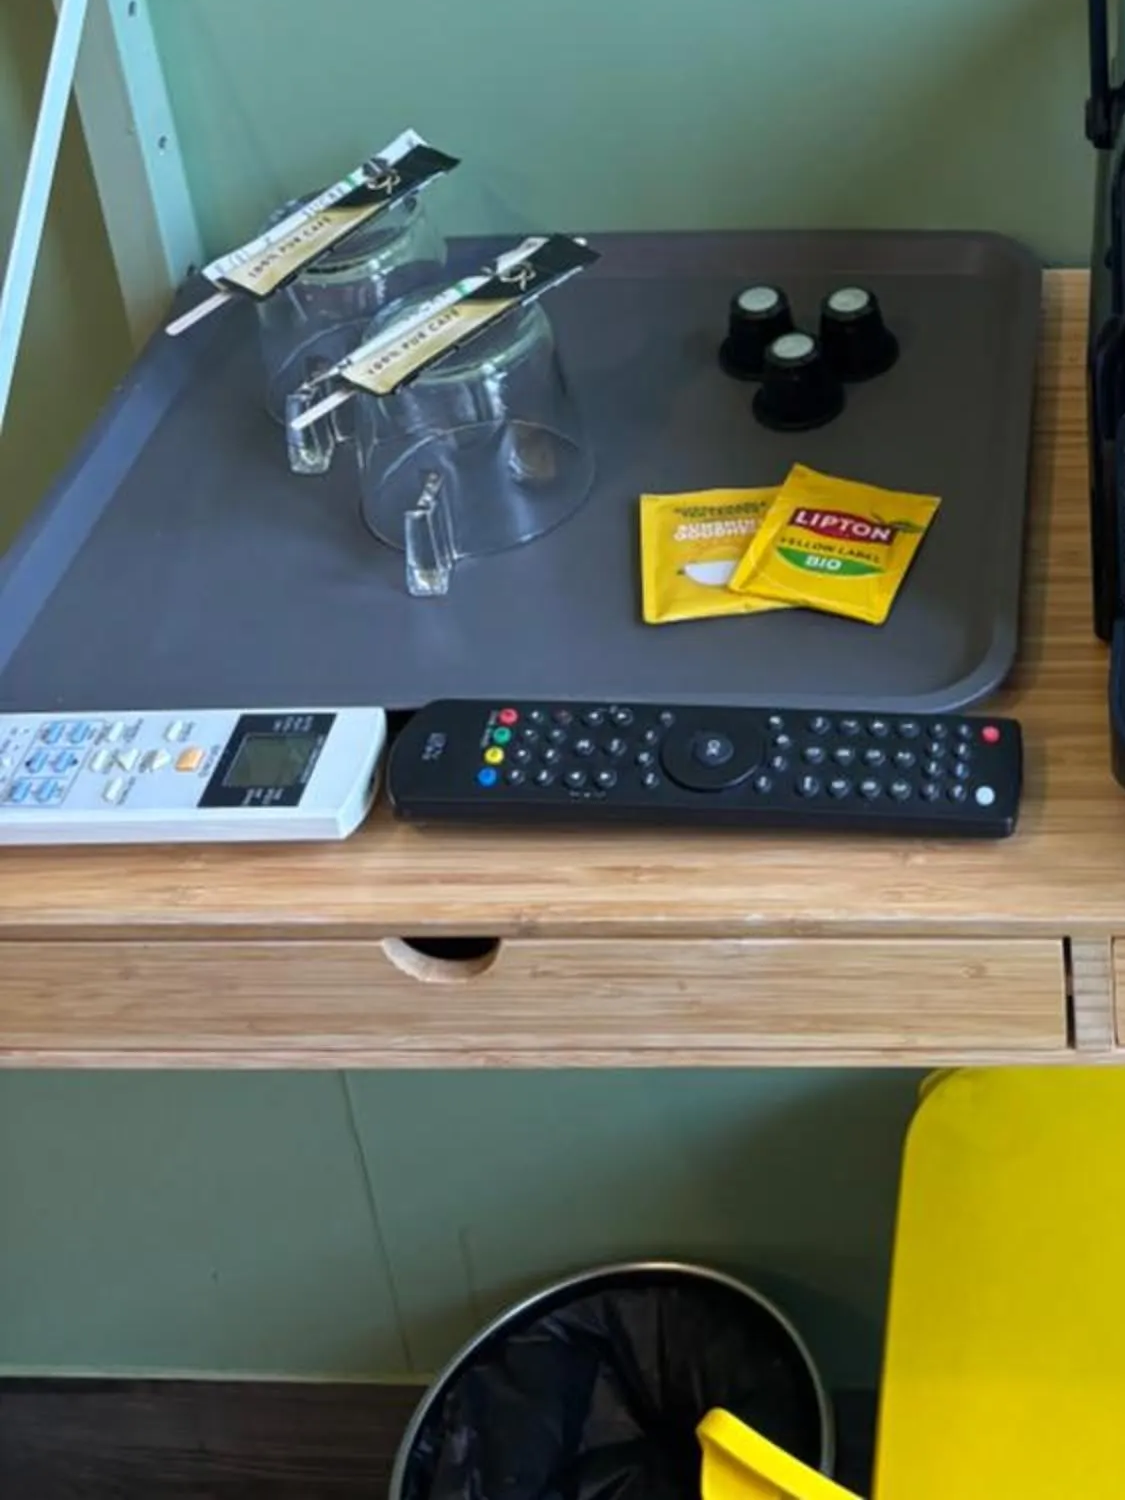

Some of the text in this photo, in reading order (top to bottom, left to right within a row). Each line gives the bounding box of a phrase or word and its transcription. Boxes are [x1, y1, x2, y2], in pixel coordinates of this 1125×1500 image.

[794, 510, 892, 541] LIPTON
[780, 537, 880, 564] YELLOW LABEL
[804, 554, 842, 572] BIO
